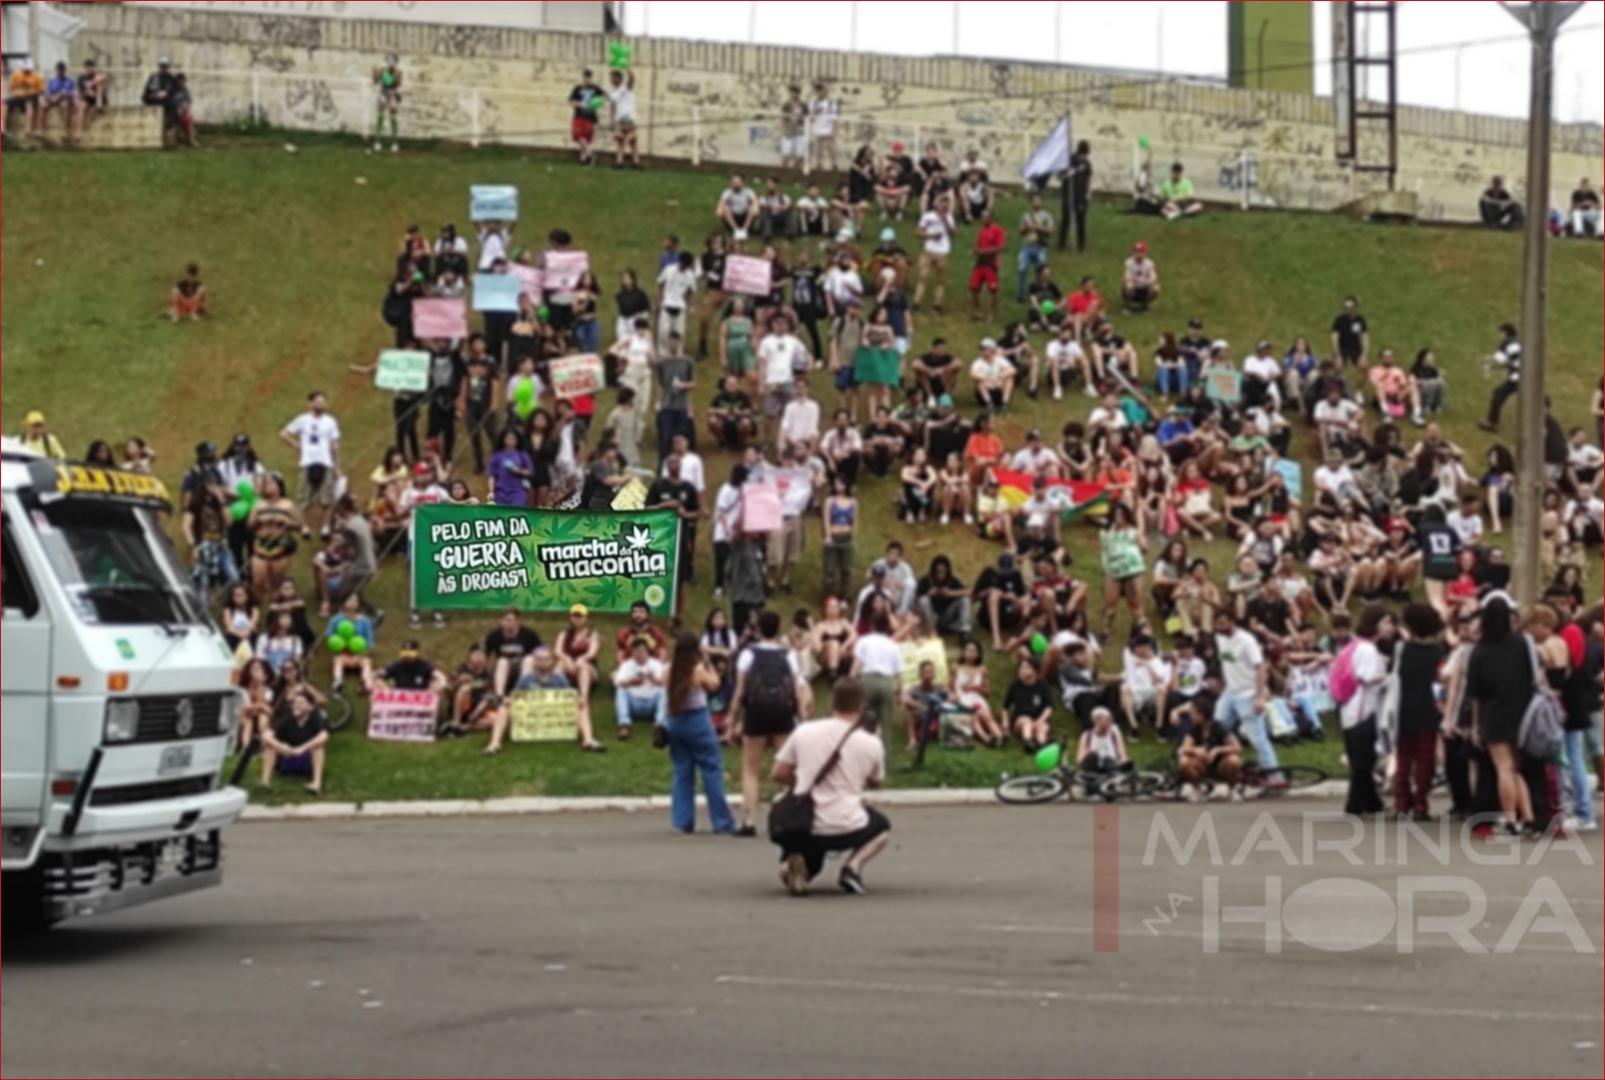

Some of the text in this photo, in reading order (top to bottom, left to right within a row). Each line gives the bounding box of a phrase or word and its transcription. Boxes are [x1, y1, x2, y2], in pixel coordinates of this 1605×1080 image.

[431, 517, 530, 543] PELO FIM DA
[541, 539, 632, 561] marcha da
[549, 550, 666, 579] maconha
[437, 571, 457, 594] ÀS
